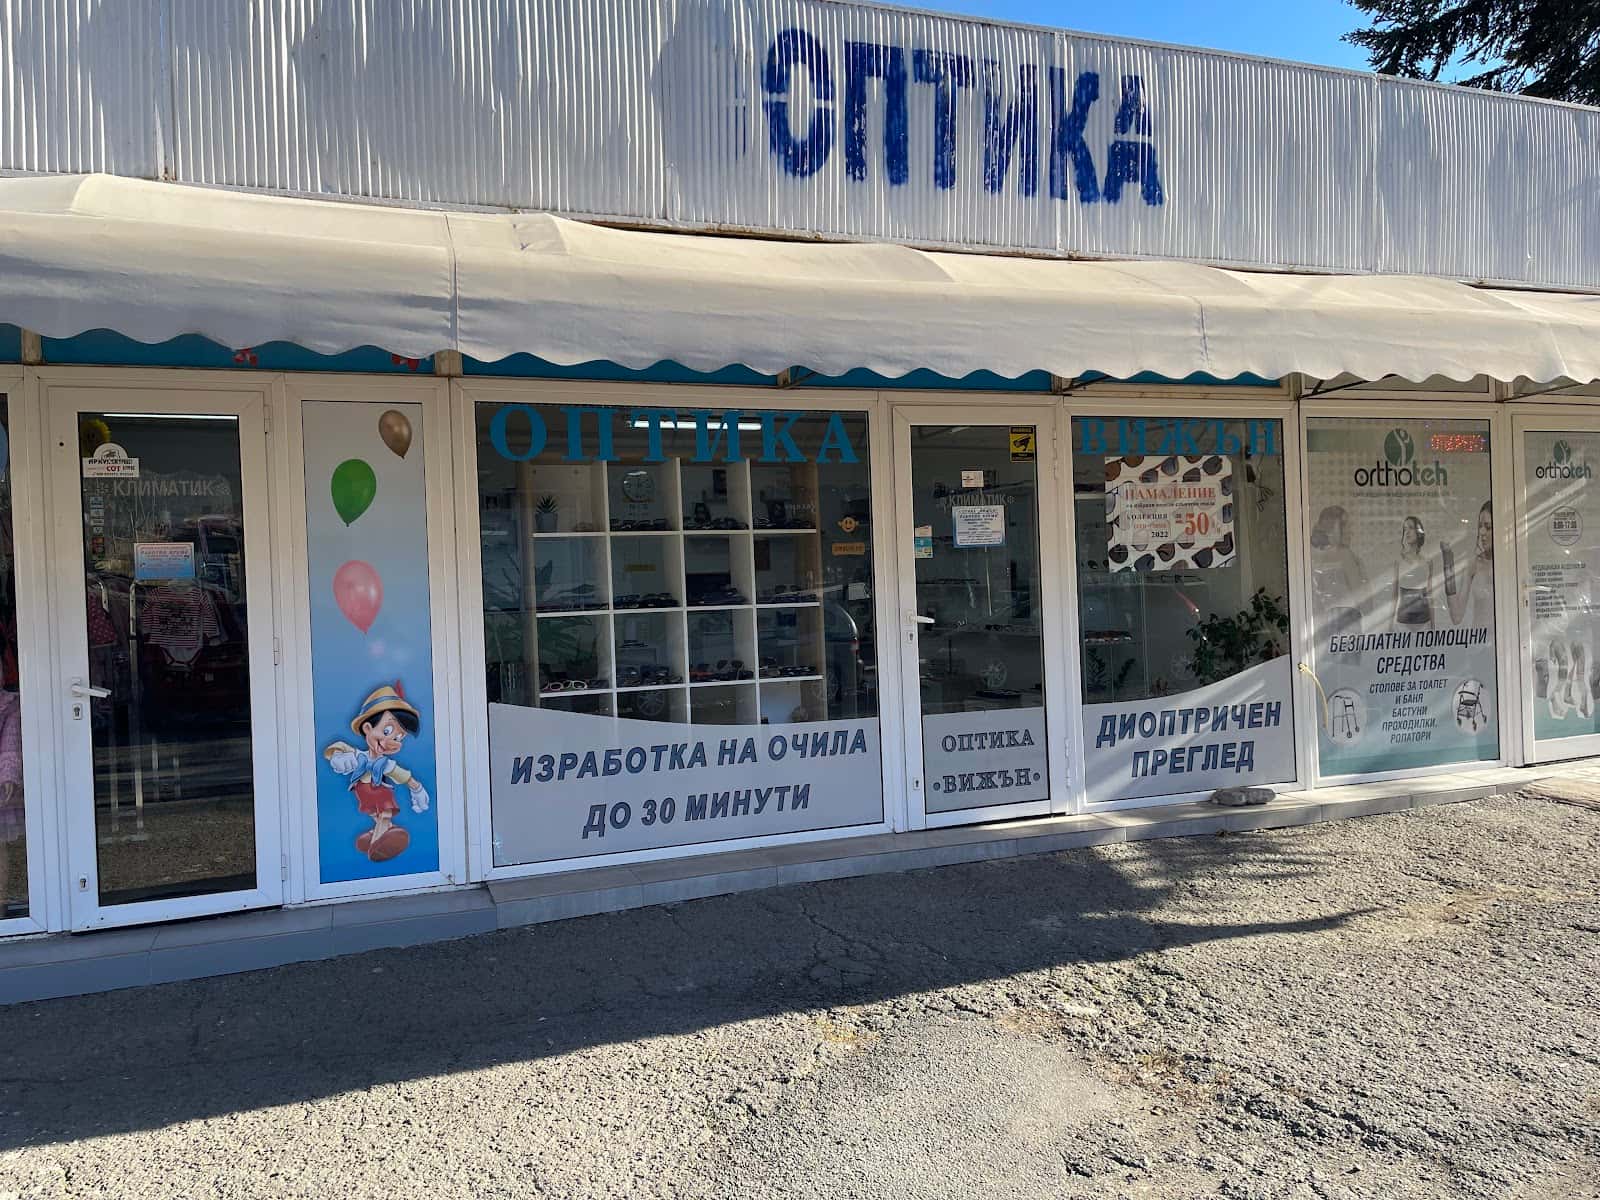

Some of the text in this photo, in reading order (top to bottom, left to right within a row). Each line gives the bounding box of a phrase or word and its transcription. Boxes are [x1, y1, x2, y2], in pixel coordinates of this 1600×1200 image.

[764, 28, 1164, 206] ОПТИКА
[489, 403, 859, 463] ОПТИКА
[1077, 418, 1279, 455] ВИЖЪН
[1354, 460, 1448, 487] orthoteh
[1535, 460, 1592, 479] orthoteh
[113, 479, 215, 497] КЛИМАТИК
[1125, 487, 1216, 500] НАМАЛЕНИЕ
[1330, 627, 1488, 653] БЕЗПЛАТНИ ПОМОЩНИ
[1376, 653, 1446, 676] СРЕДСТВА
[1369, 678, 1448, 695] СТОЛОВЕ ЗА ТОАЛЕТ
[1395, 692, 1424, 705] И БАНЯ
[1095, 701, 1282, 749] ДИОПТРИЧЕН
[1391, 707, 1428, 719] БАСТУНИ
[941, 728, 1035, 753] ОПТИКА
[1390, 731, 1432, 745] РОЛАТОРИ
[510, 728, 867, 785] ИЗРАБОТКА НА ОЧИЛА
[1132, 740, 1255, 778] ПРЕГЛЕД
[582, 783, 811, 840] ДО 30 МИНУТИ
